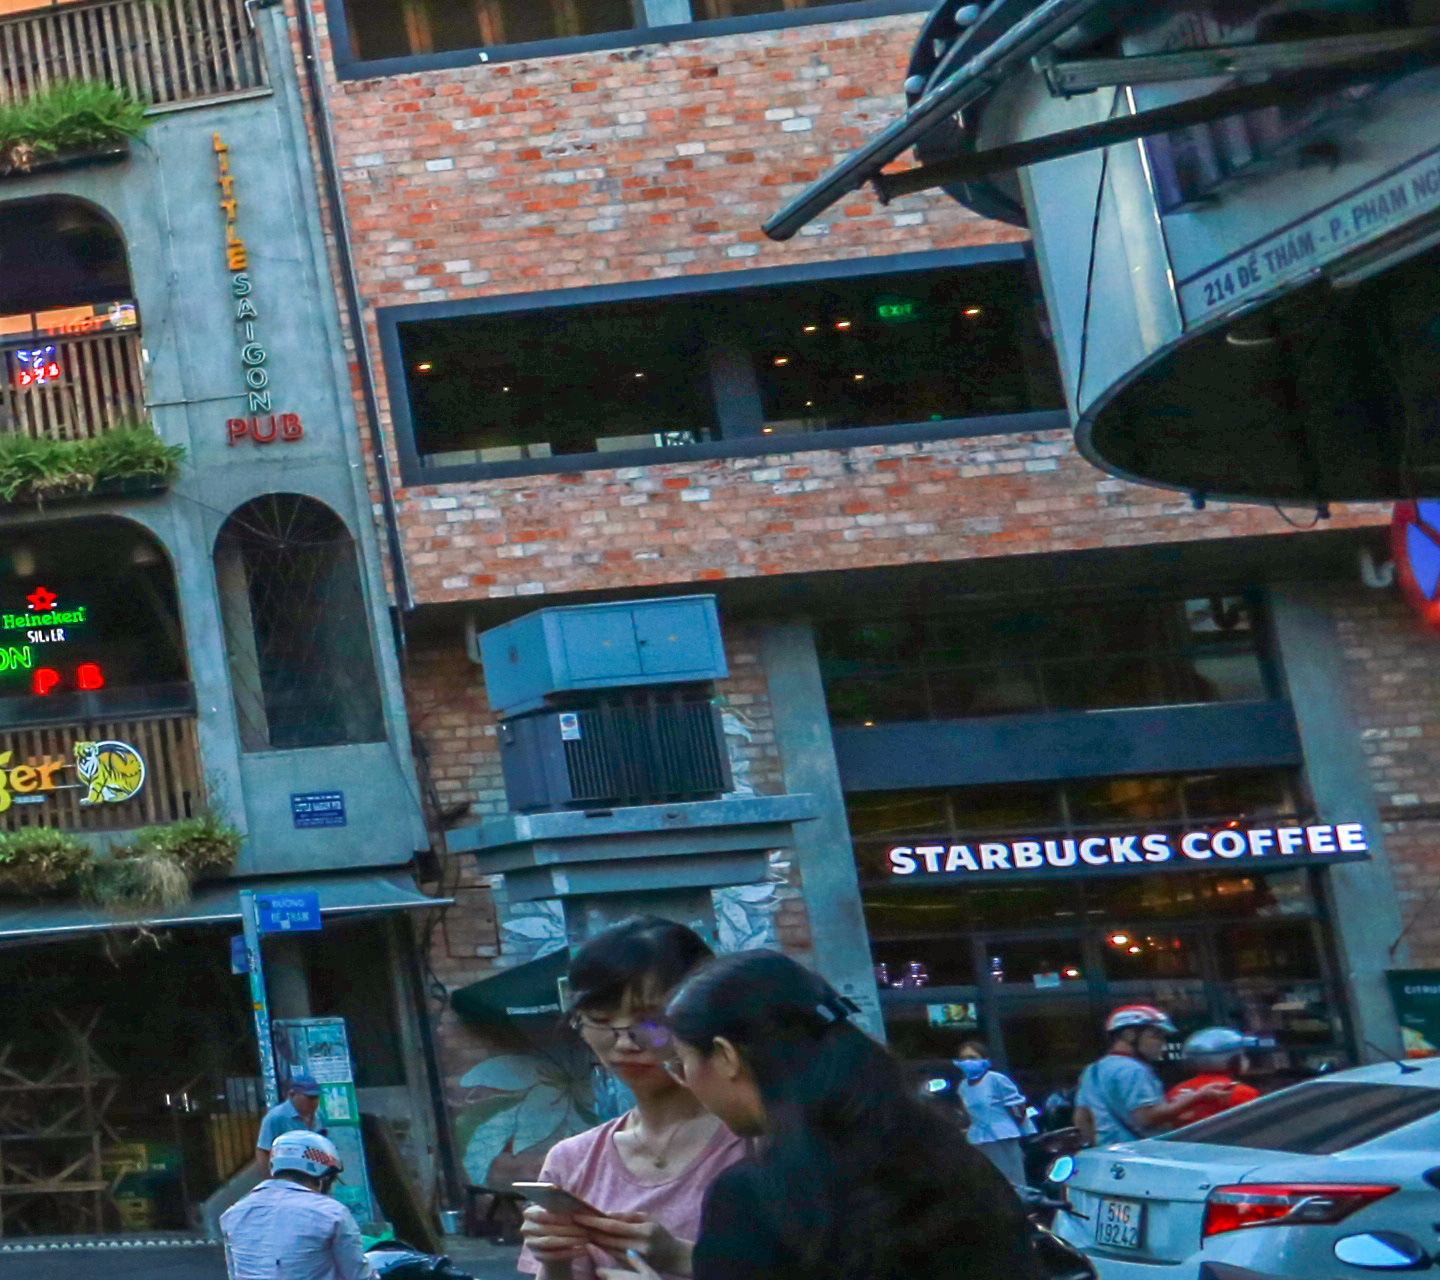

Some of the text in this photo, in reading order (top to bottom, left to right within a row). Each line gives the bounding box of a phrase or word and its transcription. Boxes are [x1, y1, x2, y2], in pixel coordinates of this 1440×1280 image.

[212, 132, 247, 270] LITTLE
[1204, 271, 1235, 306] 214
[232, 273, 272, 412] SAIGON
[226, 413, 304, 446] PUB
[3, 607, 85, 629] Heineken
[888, 821, 1368, 876] STARBUCKS COFFEE
